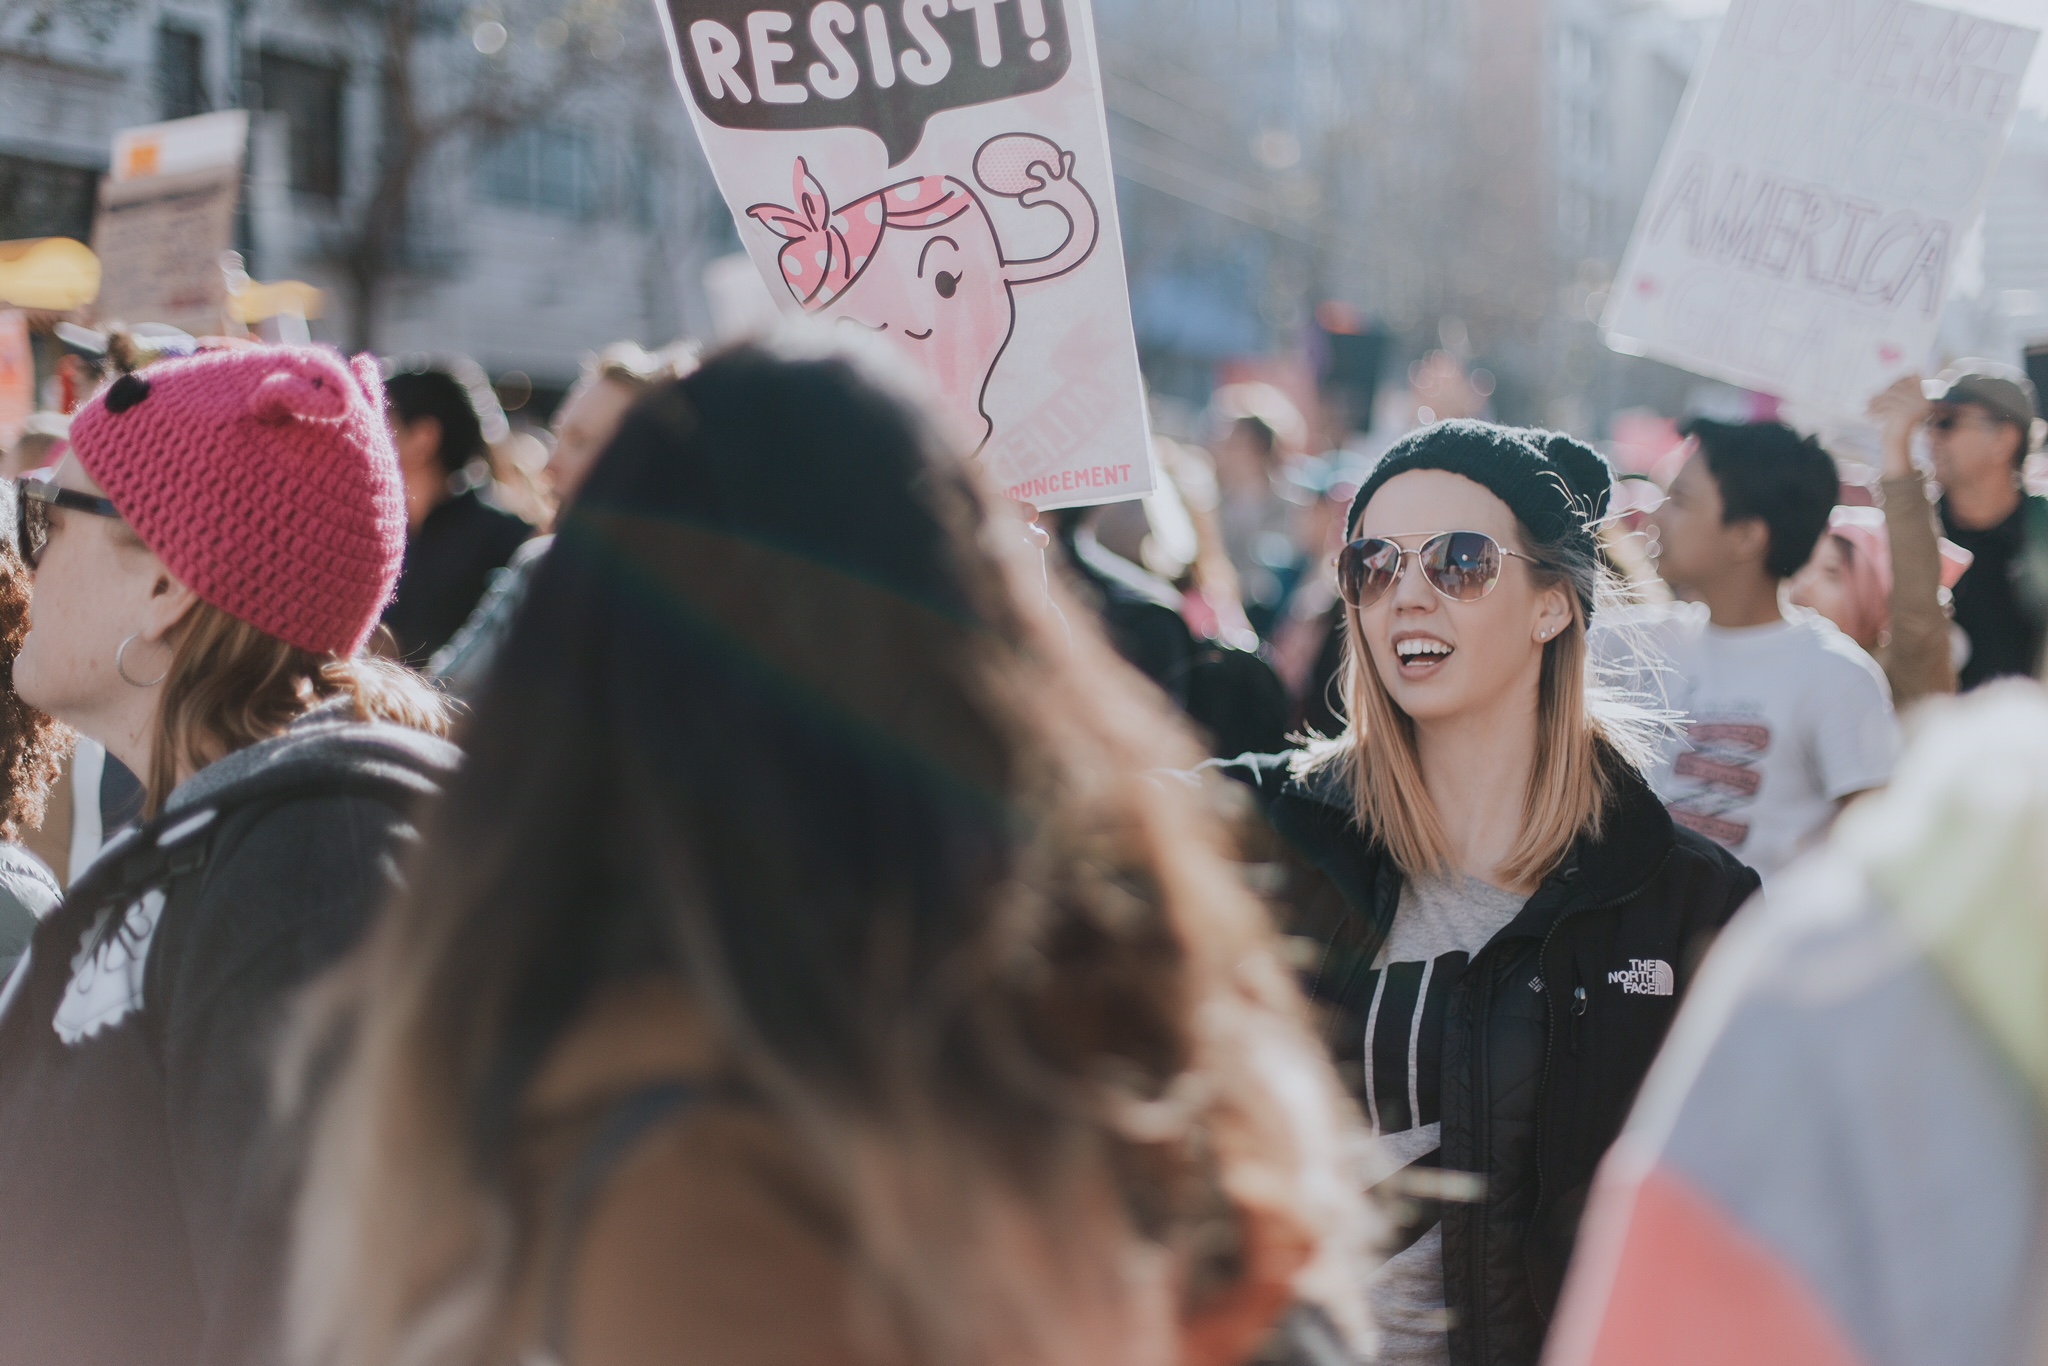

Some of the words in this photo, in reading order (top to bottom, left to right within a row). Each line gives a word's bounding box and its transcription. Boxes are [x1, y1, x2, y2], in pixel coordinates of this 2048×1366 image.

[690, 0, 1051, 104] RESIST!
[1728, 0, 1927, 89] LOVE
[1649, 150, 1953, 320] AMERICA
[1003, 463, 1132, 500] OUNCEMENT
[1608, 970, 1656, 984] NORTH
[1629, 959, 1656, 971] THE
[1623, 982, 1656, 995] FACE
